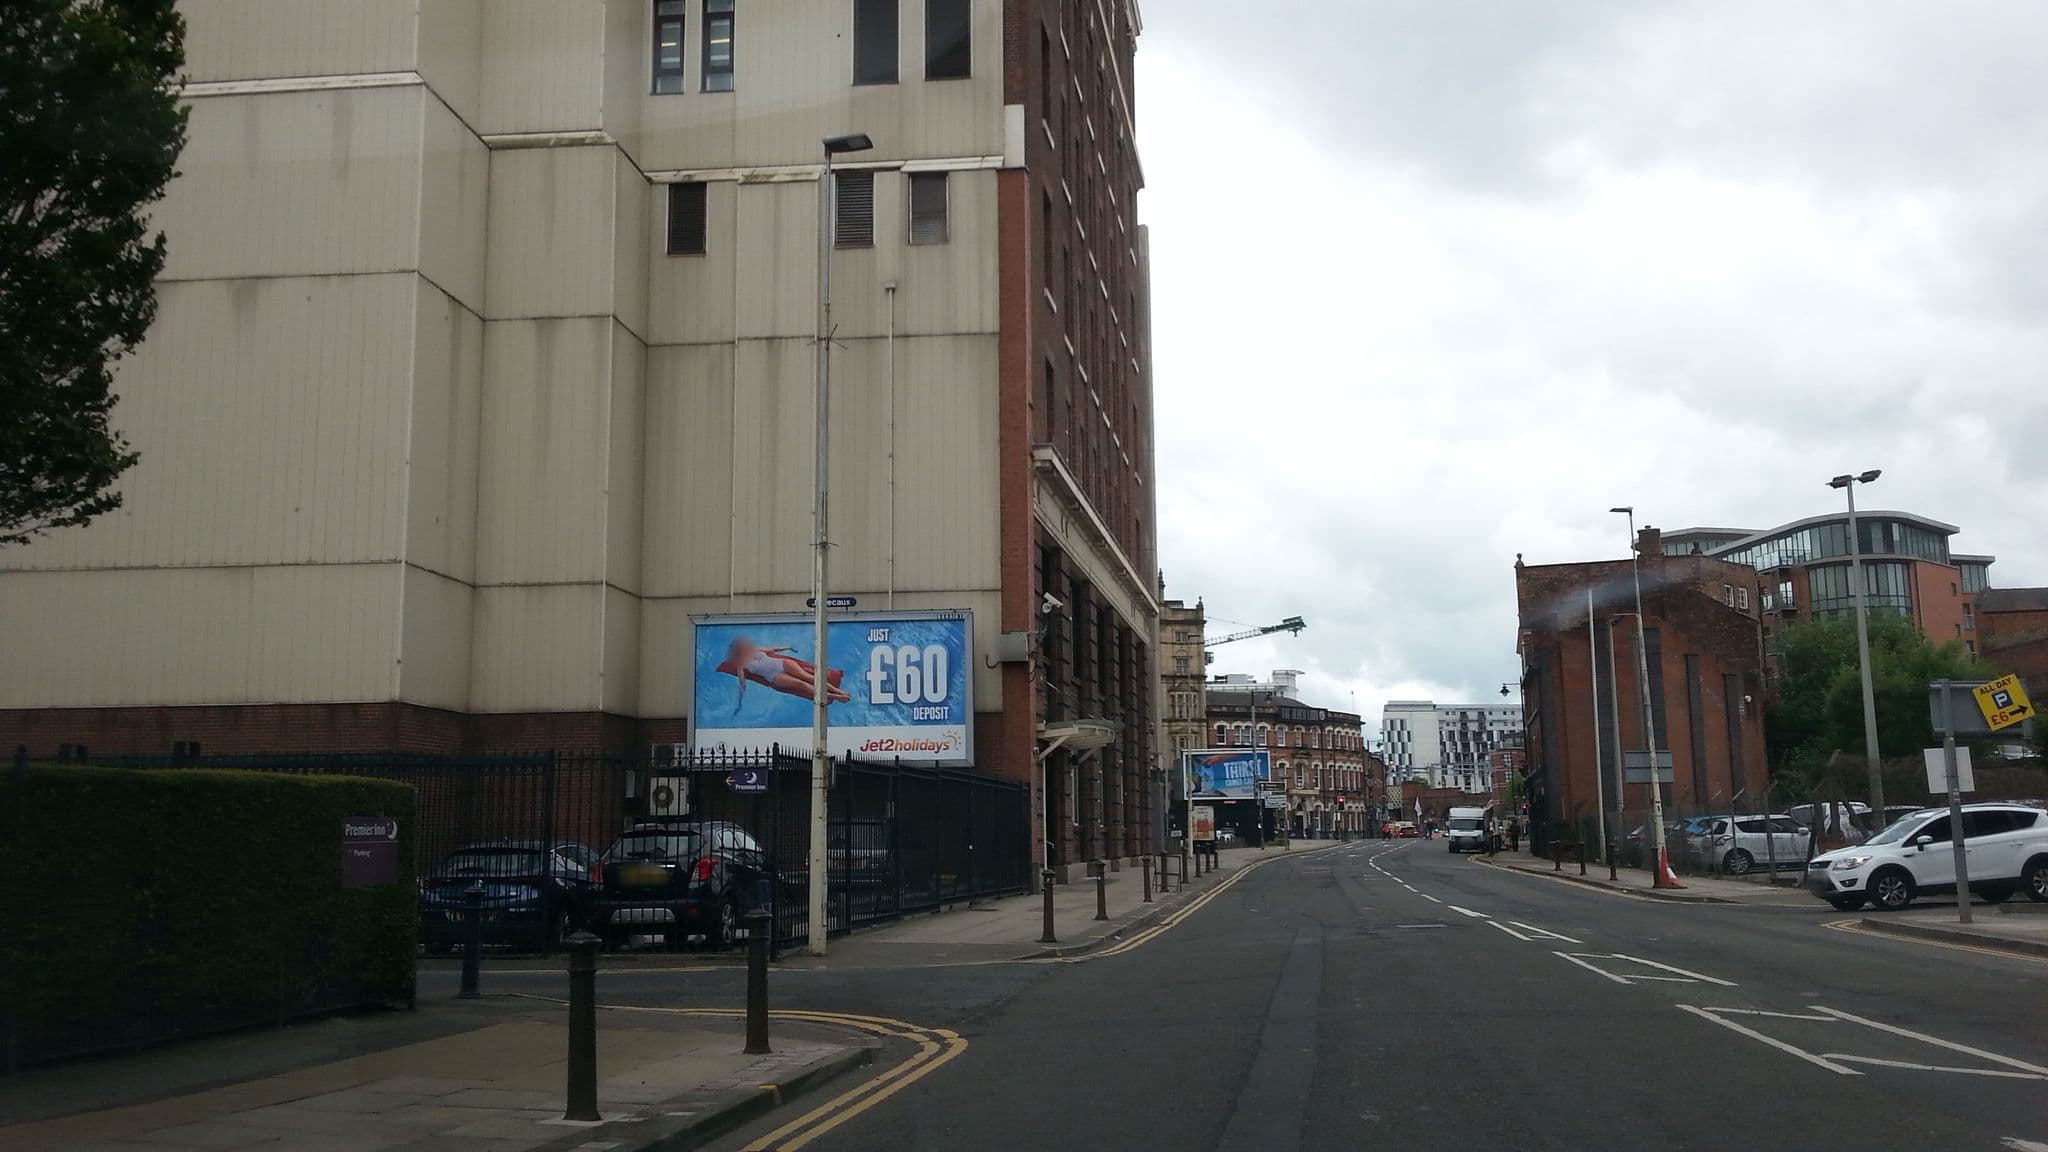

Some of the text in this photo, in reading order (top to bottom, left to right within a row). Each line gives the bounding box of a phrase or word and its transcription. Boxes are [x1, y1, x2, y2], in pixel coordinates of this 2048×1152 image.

[868, 629, 889, 642] JUST
[866, 644, 948, 704] £60
[1979, 677, 2012, 695] ALL DAY
[1995, 693, 2007, 706] P
[913, 707, 949, 720] DEPOSIT
[1991, 712, 2009, 725] £6
[860, 739, 950, 753] jet2holidays
[1223, 759, 1262, 779] THIRST
[345, 824, 386, 836] Premier Inn
